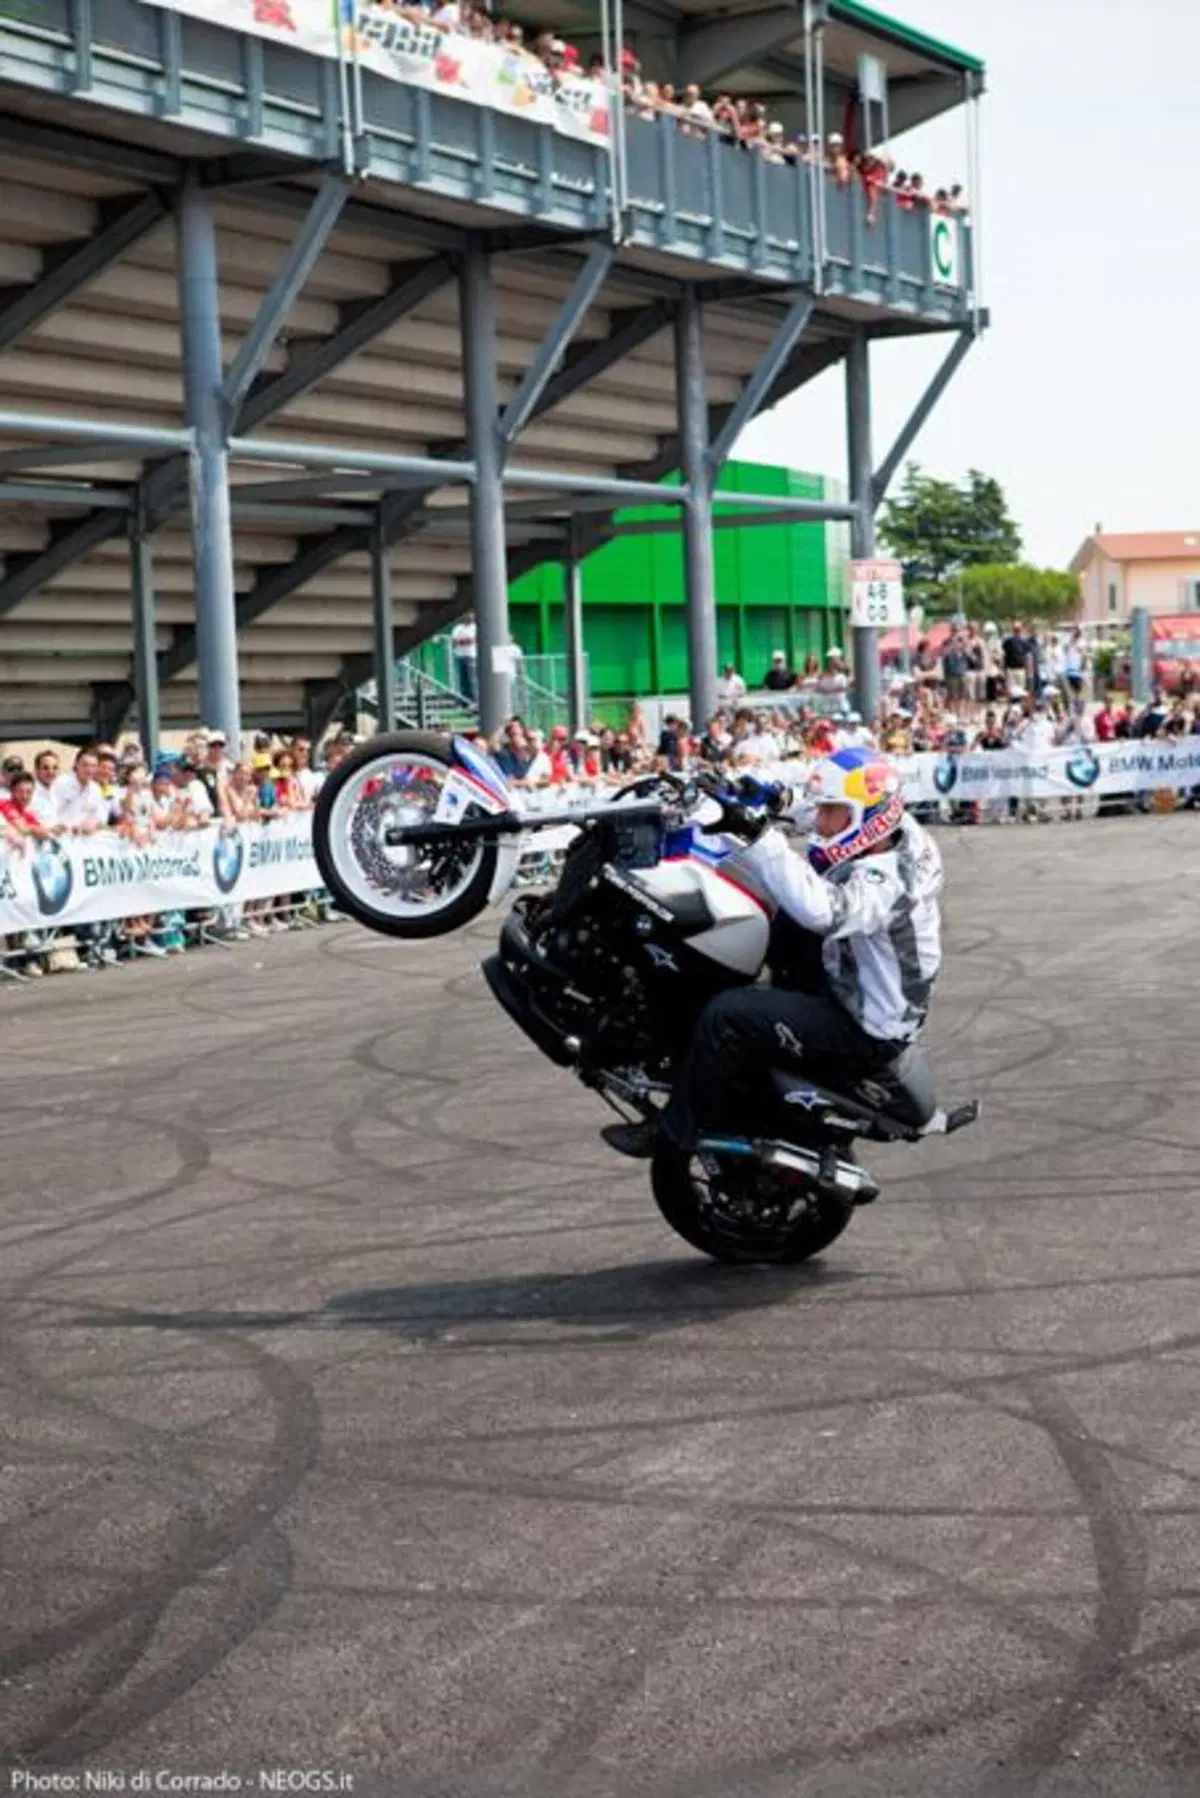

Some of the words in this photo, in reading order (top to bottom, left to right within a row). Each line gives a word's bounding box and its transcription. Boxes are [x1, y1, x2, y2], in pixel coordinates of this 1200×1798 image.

[934, 221, 952, 277] C
[1109, 755, 1154, 774] BMW
[248, 840, 282, 868] BMW
[83, 855, 135, 888] BMW
